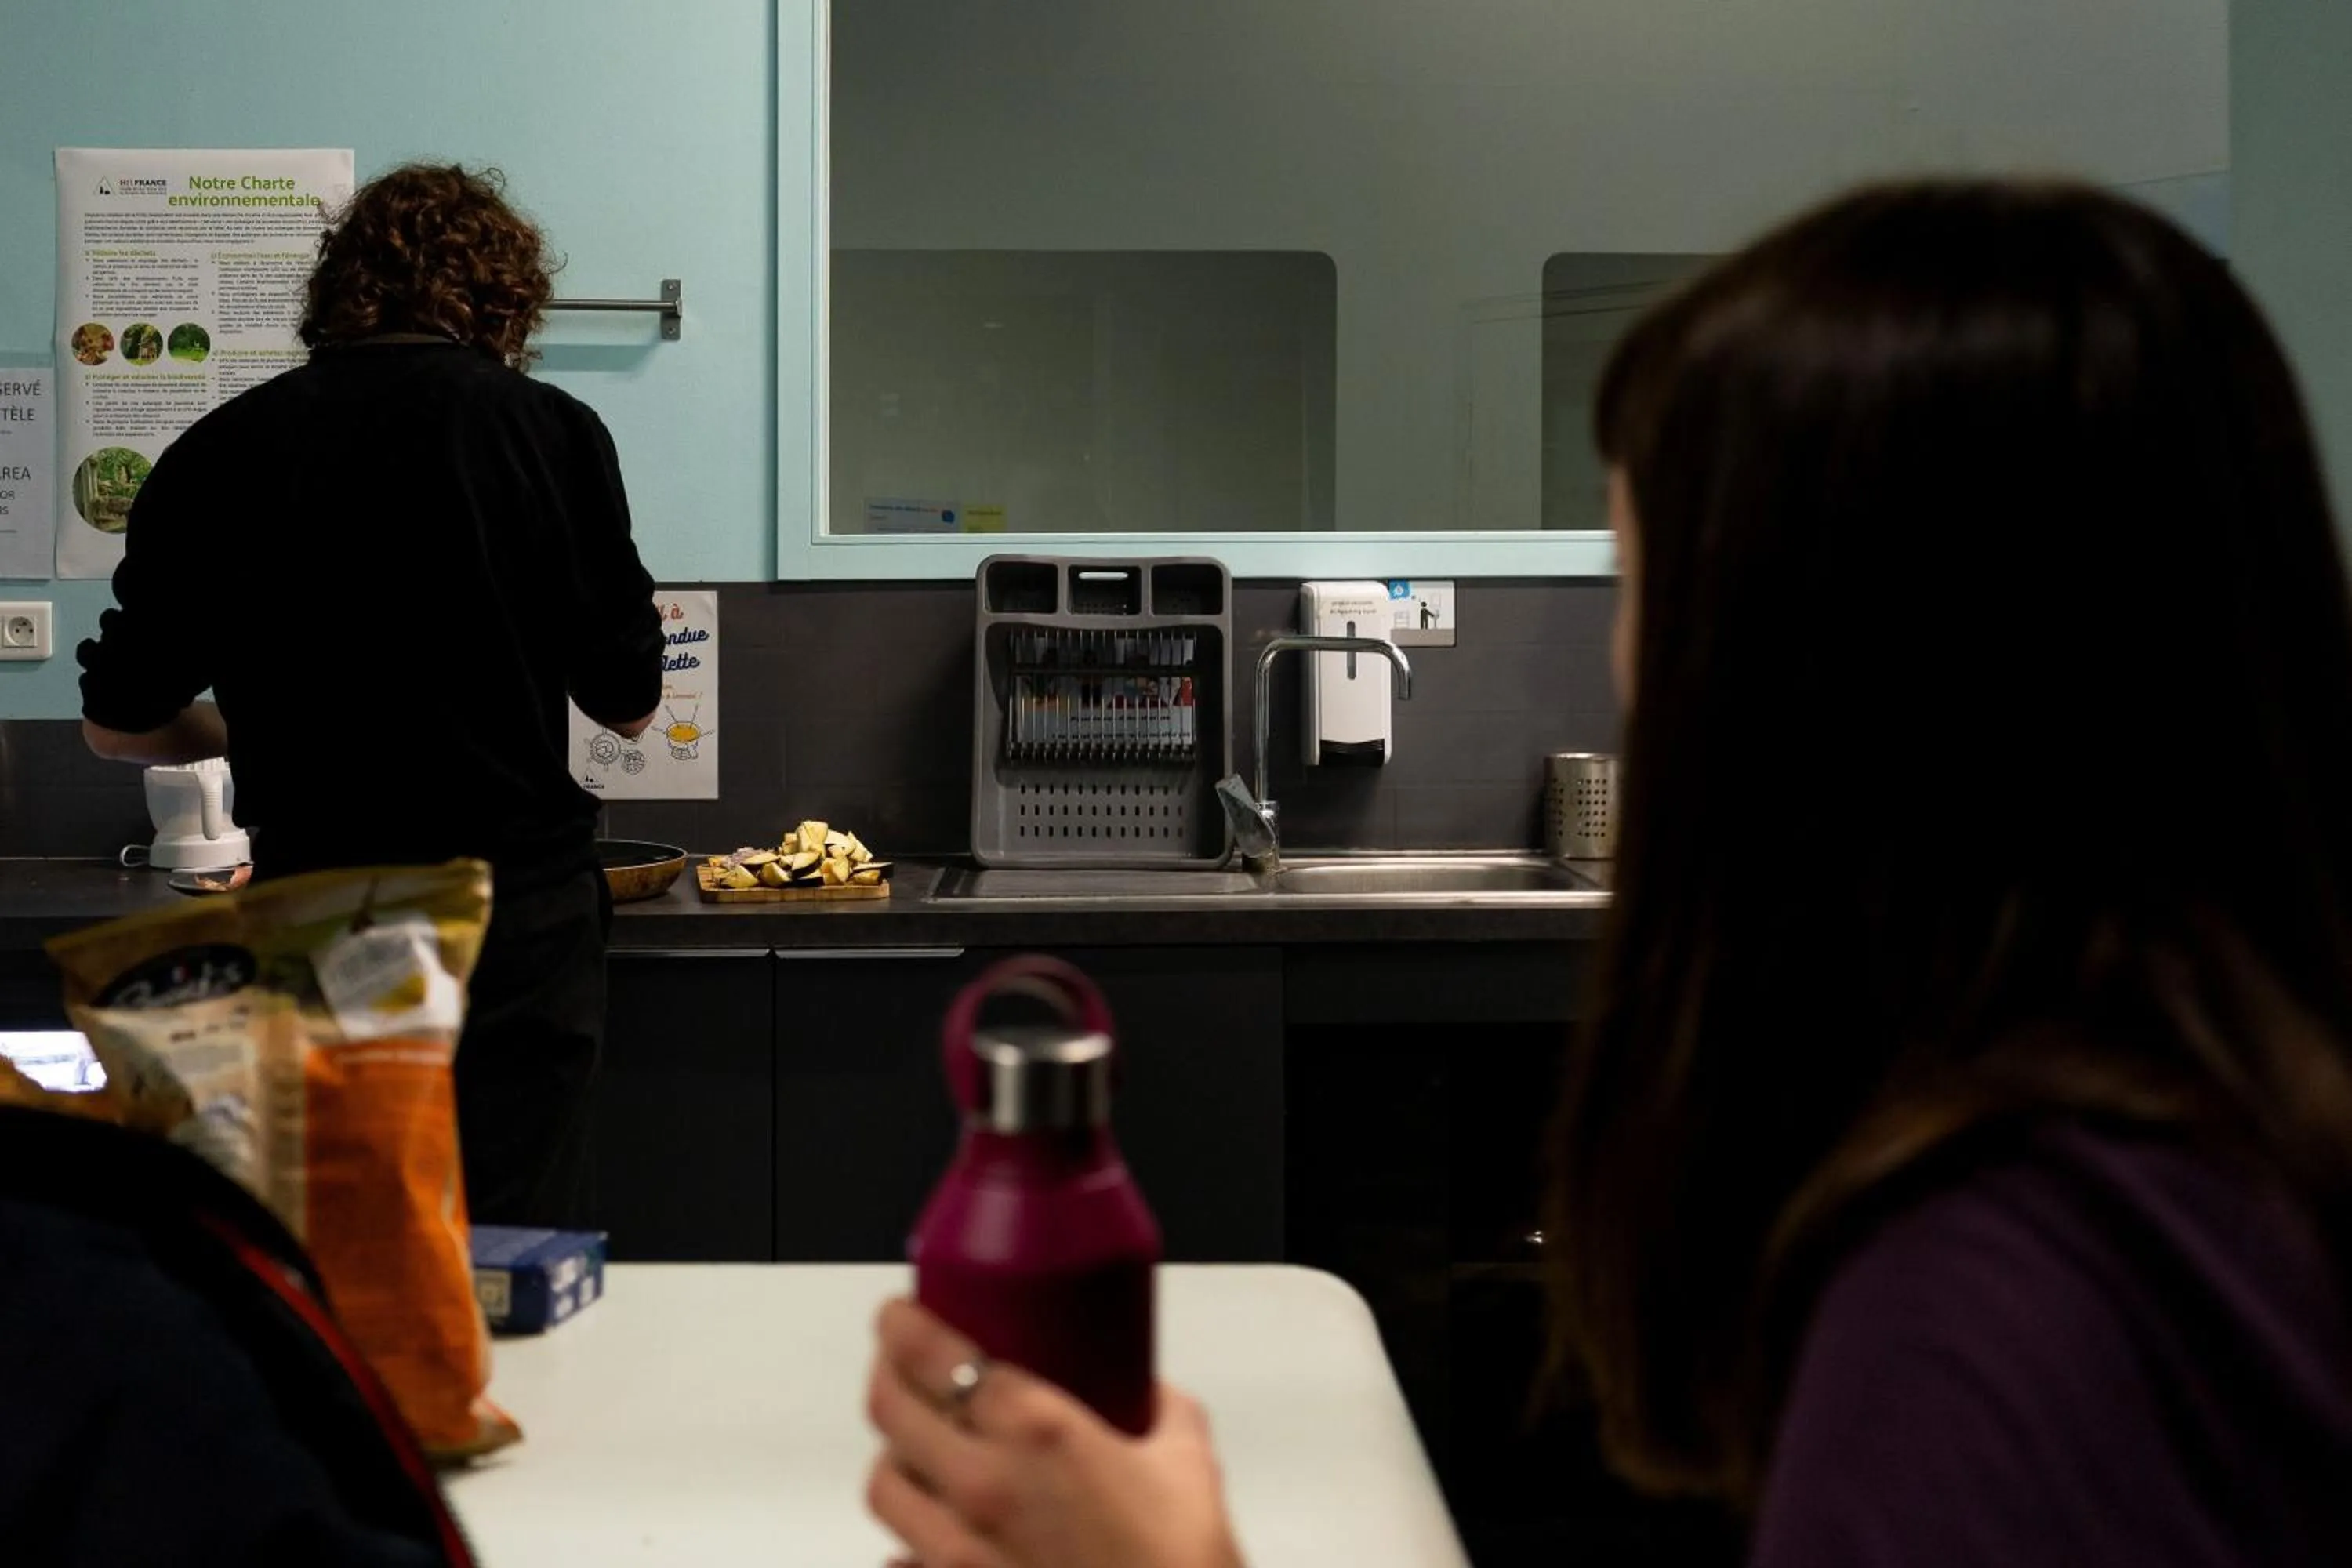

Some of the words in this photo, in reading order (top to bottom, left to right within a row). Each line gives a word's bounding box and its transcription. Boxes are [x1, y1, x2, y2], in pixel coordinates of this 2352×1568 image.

[189, 175, 236, 190] Notre
[241, 175, 296, 190] Charte
[169, 193, 321, 206] environnementale
[0, 466, 31, 481] REA
[665, 627, 710, 645] ndue
